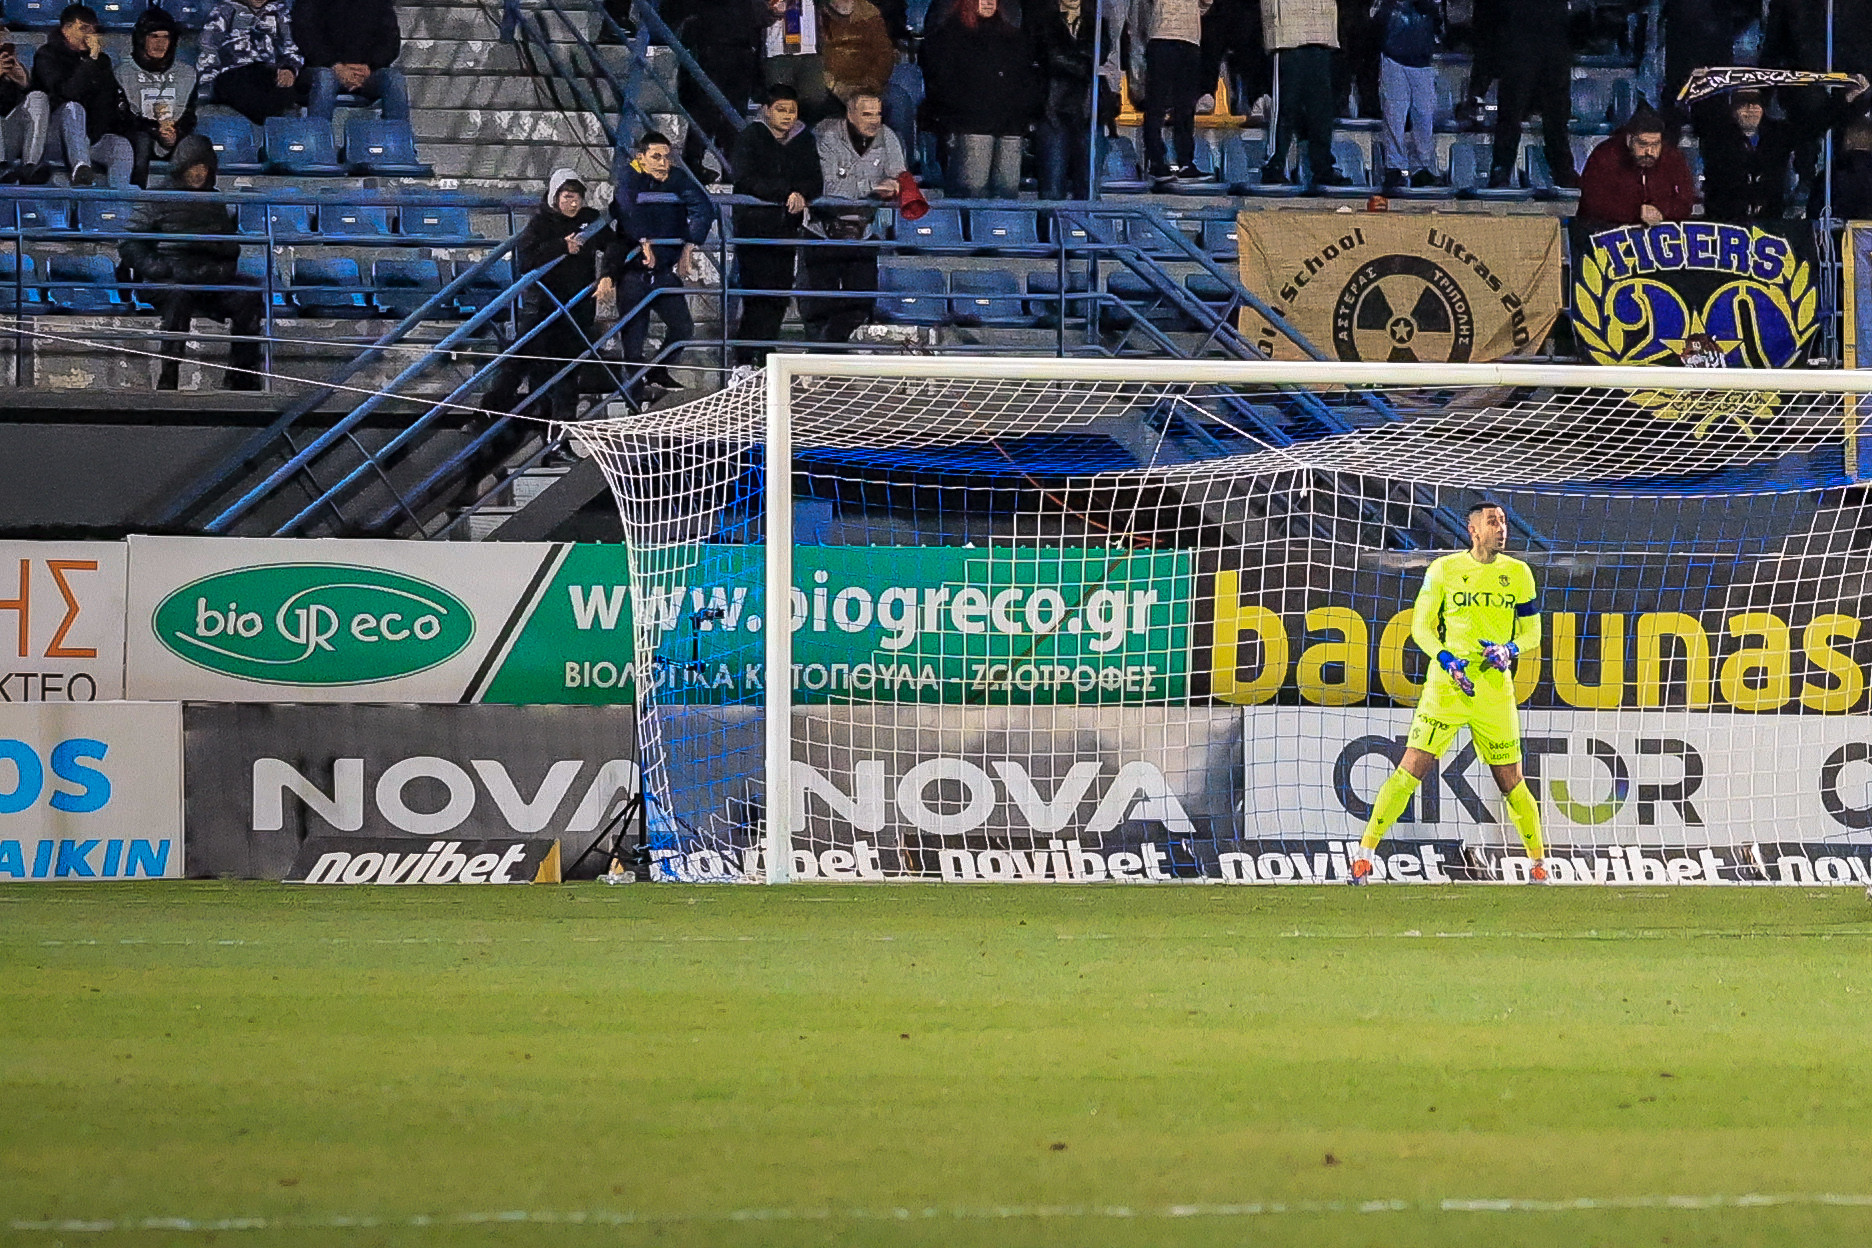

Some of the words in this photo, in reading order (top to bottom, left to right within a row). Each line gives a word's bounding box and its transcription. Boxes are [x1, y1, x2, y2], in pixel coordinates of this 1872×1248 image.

[1589, 221, 1791, 284] TIGERS
[745, 661, 939, 692] ΚΤΟΠΟΥΛΑ
[971, 663, 1158, 693] ΖΩΟΤΡΟΦΕΣ
[767, 756, 1196, 835] NOVA
[303, 840, 529, 885] novibet
[940, 840, 1172, 883] novibet
